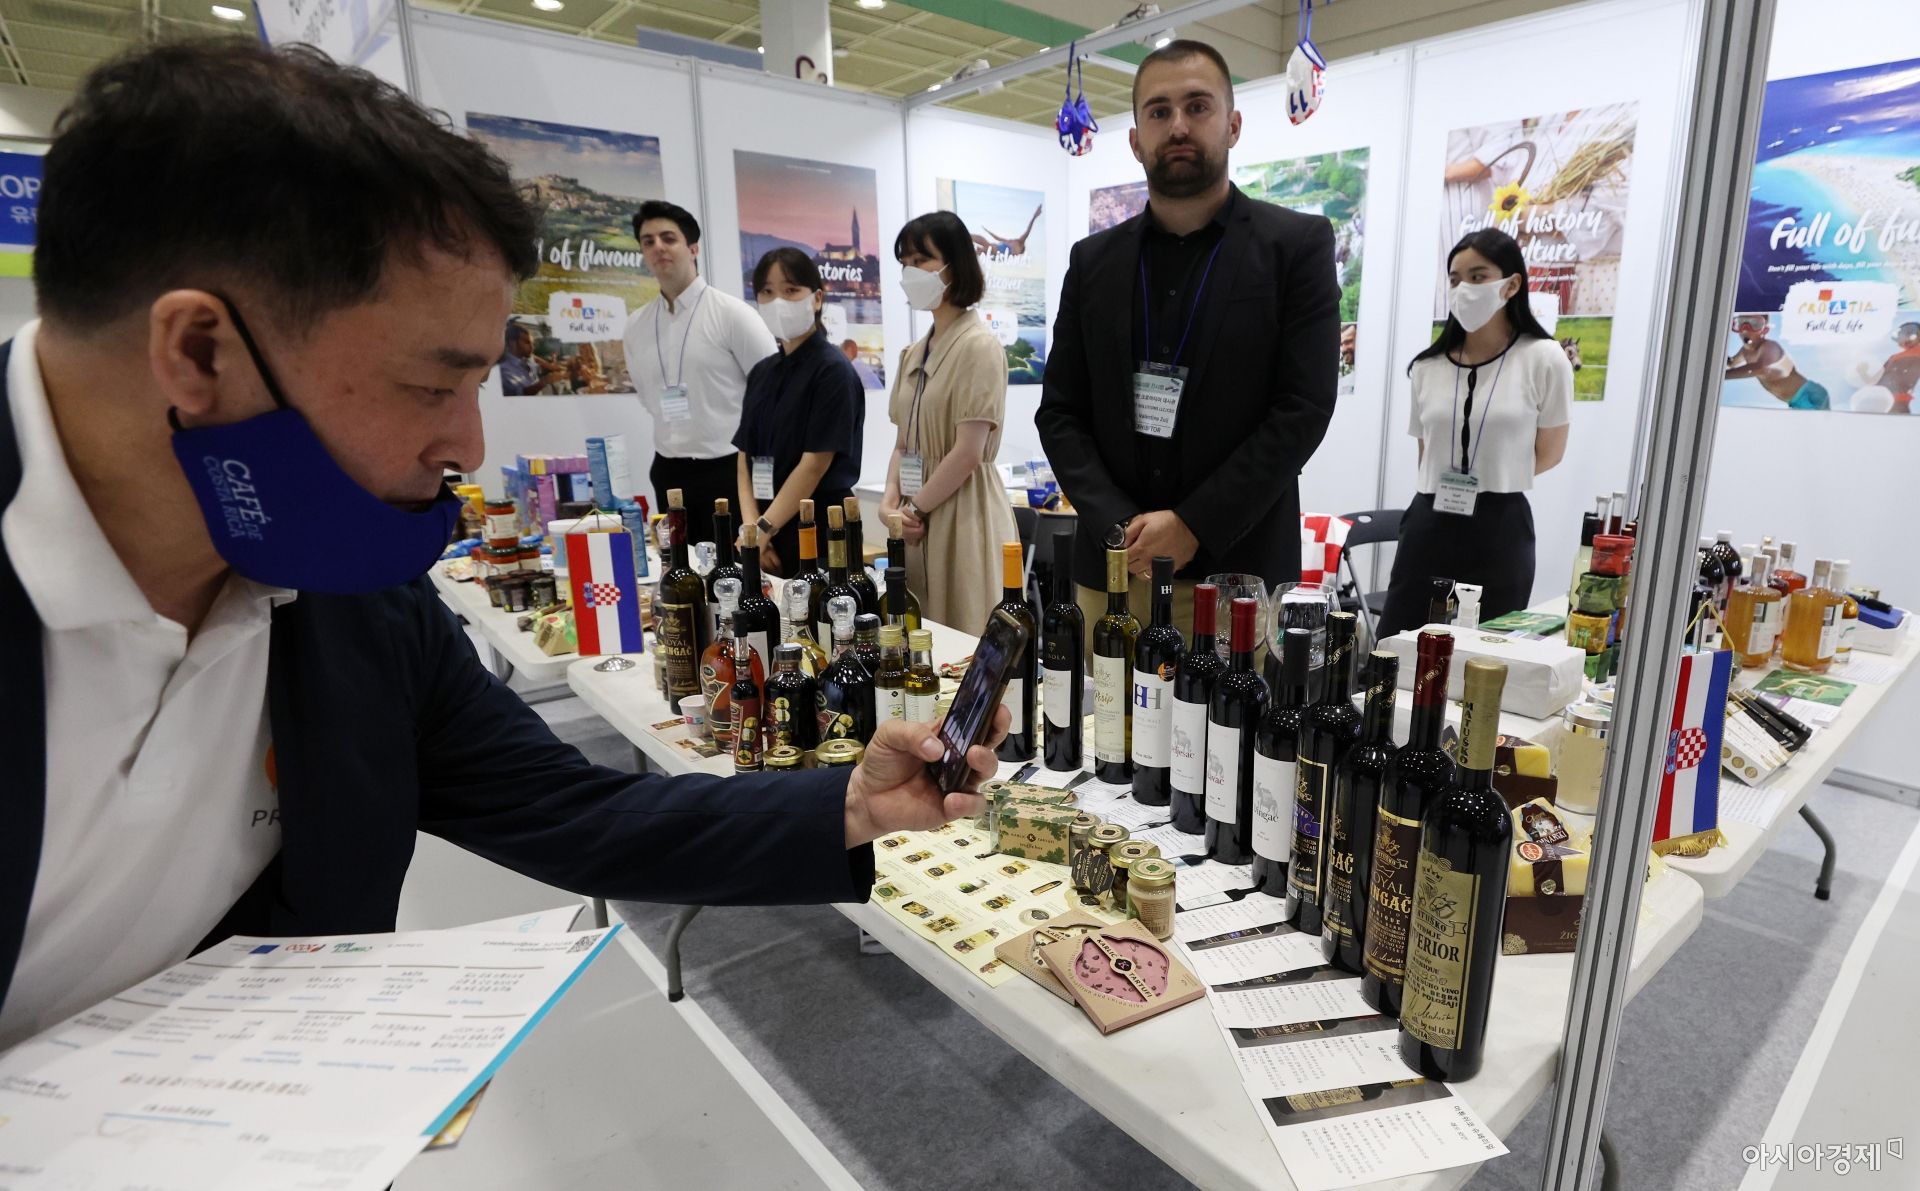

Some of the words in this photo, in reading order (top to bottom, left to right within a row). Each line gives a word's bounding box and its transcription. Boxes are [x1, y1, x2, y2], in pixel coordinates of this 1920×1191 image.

[1460, 208, 1496, 238] Full
[1500, 208, 1525, 240] of
[1525, 205, 1603, 238] history
[1770, 210, 1831, 251] Full
[1833, 209, 1875, 254] of
[550, 238, 574, 271] of
[817, 262, 863, 283] stories
[1798, 300, 1877, 315] CROATIA
[1806, 320, 1827, 331] Full
[203, 455, 234, 502] COSTA
[222, 459, 272, 524] CAFÉ
[1328, 847, 1354, 874] GAČ
[1370, 882, 1412, 914] INGAČ
[1373, 871, 1407, 896] OYAL
[1128, 972, 1153, 999] TARTUFI
